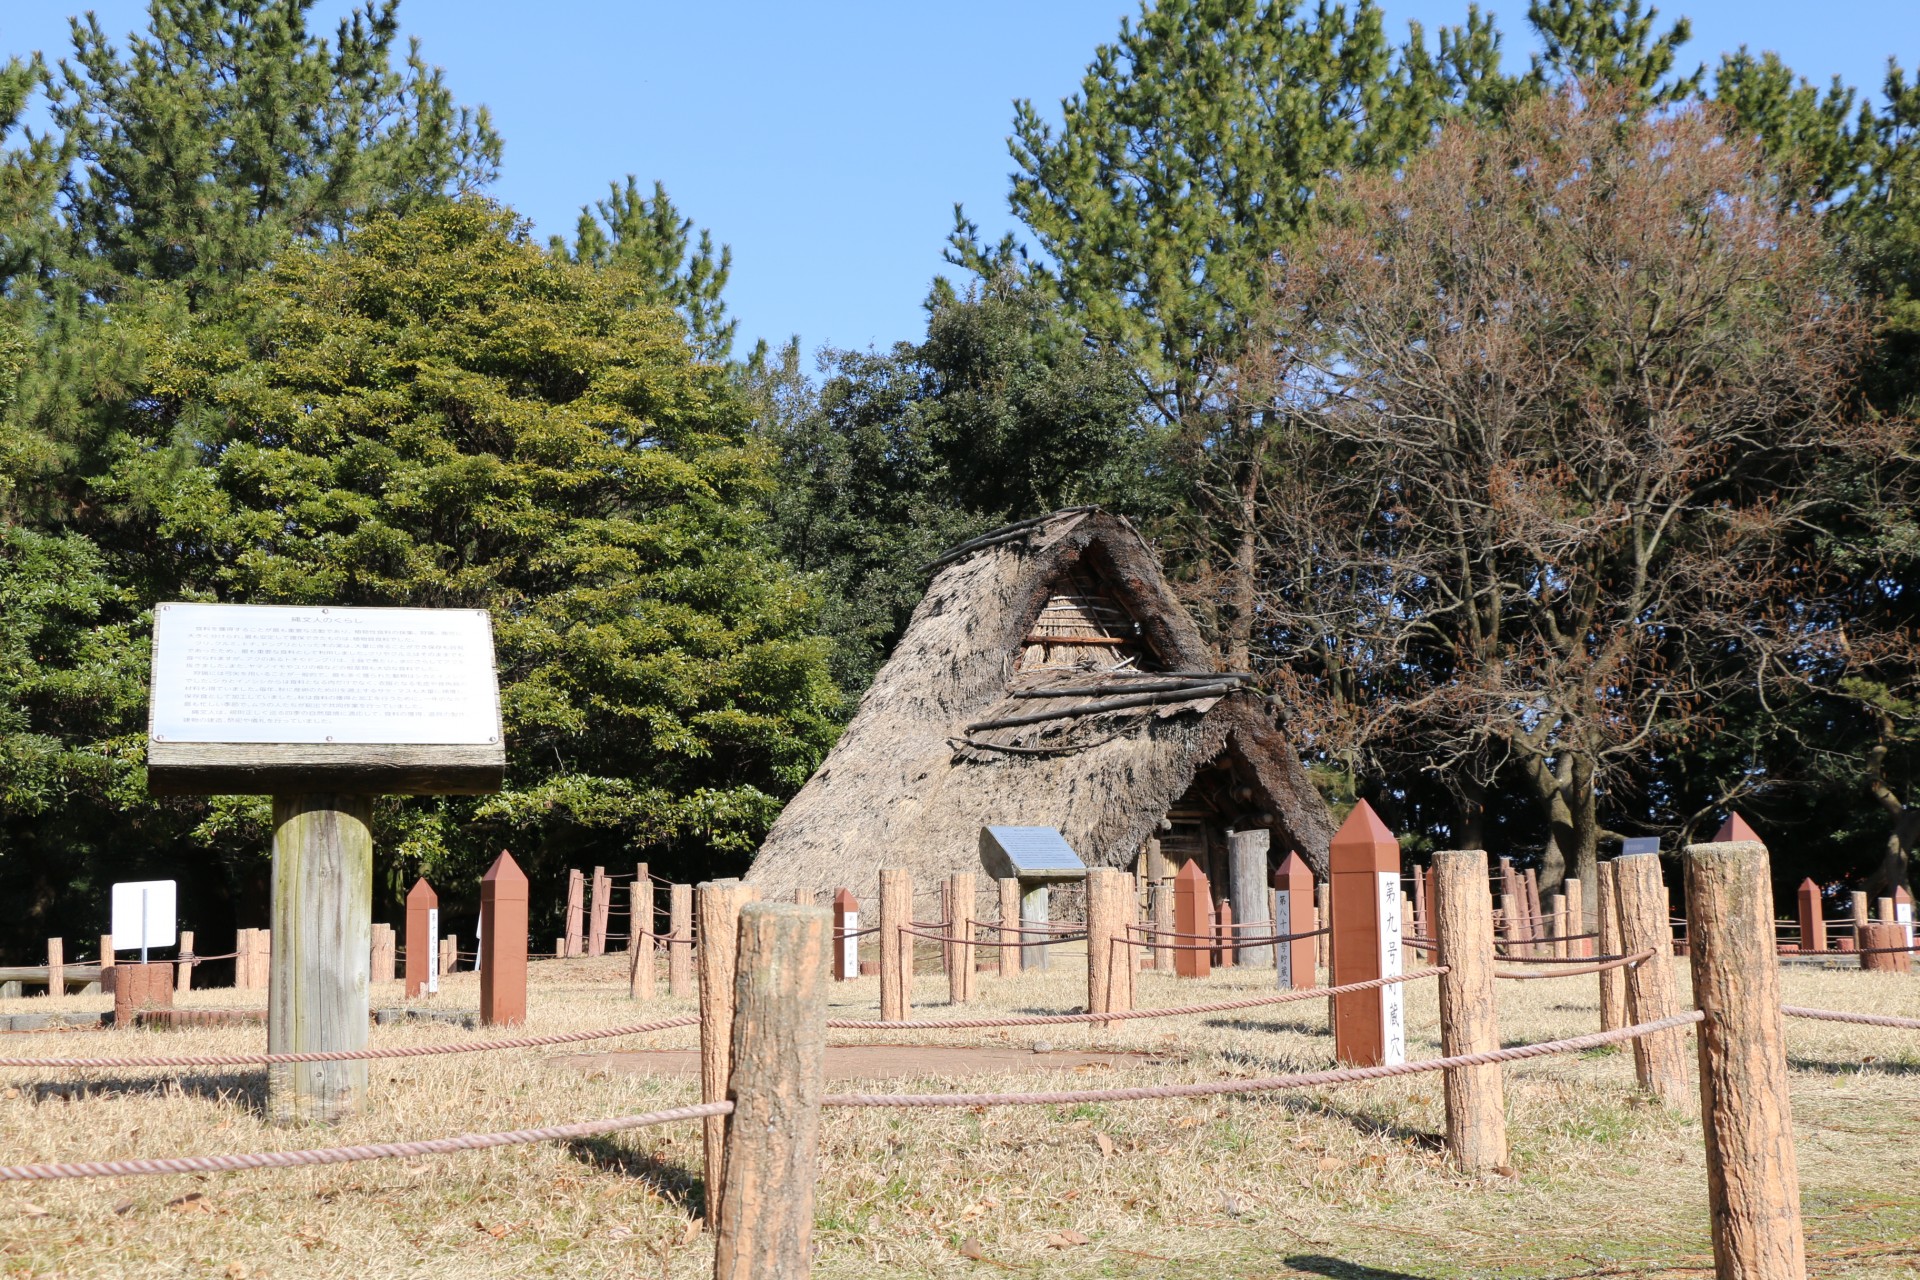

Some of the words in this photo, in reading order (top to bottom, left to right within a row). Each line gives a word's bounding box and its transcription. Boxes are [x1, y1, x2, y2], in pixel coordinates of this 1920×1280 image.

[291, 616, 365, 624] 縄文人のくらし
[1278, 895, 1289, 988] 第八十号貯蔵穴
